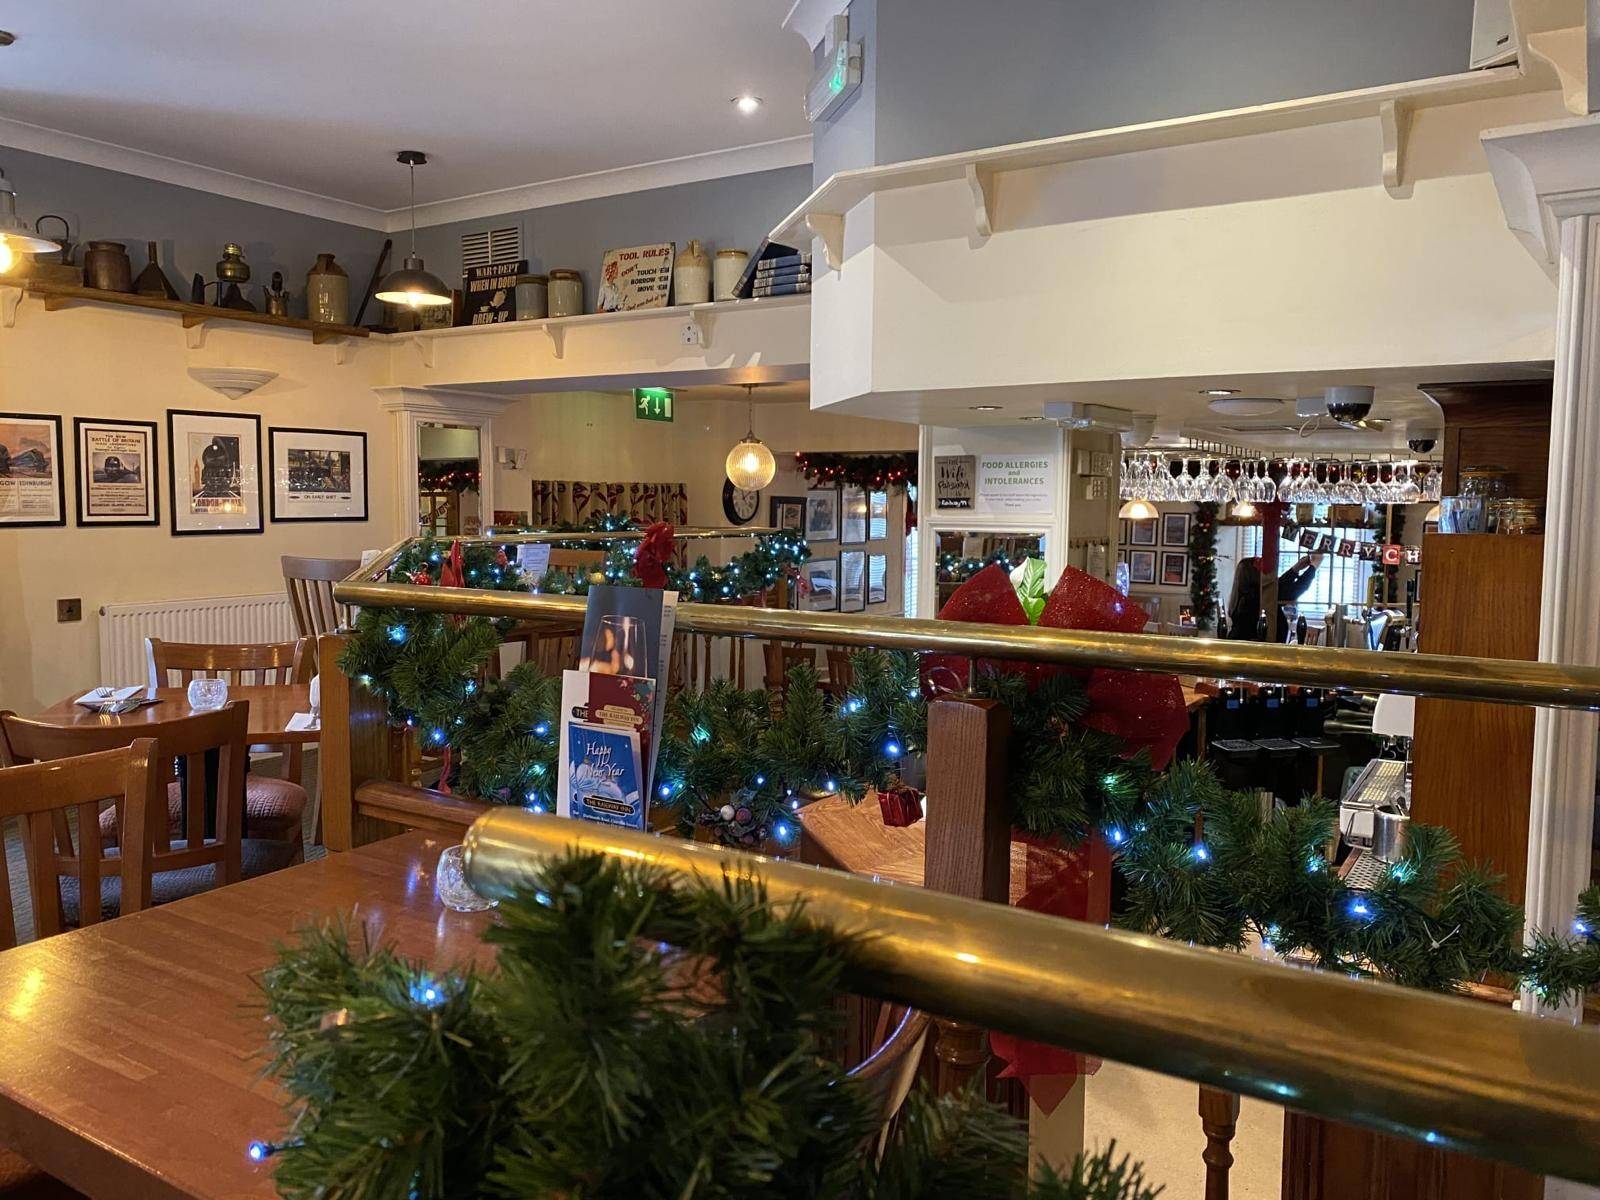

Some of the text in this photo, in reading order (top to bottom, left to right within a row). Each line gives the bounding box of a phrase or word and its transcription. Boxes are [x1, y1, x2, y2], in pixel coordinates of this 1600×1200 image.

[619, 248, 670, 260] TOOL RULES
[637, 268, 656, 276] TOUCH
[470, 279, 490, 292] WHEN
[498, 275, 517, 289] DOUB
[630, 277, 656, 285] BORROW
[1005, 461, 1048, 469] ALLERGIES
[984, 477, 1044, 485] INTOLERANCES
[1284, 525, 1375, 558] MERRY
[586, 741, 612, 767] Happy
[604, 762, 624, 777] Year
